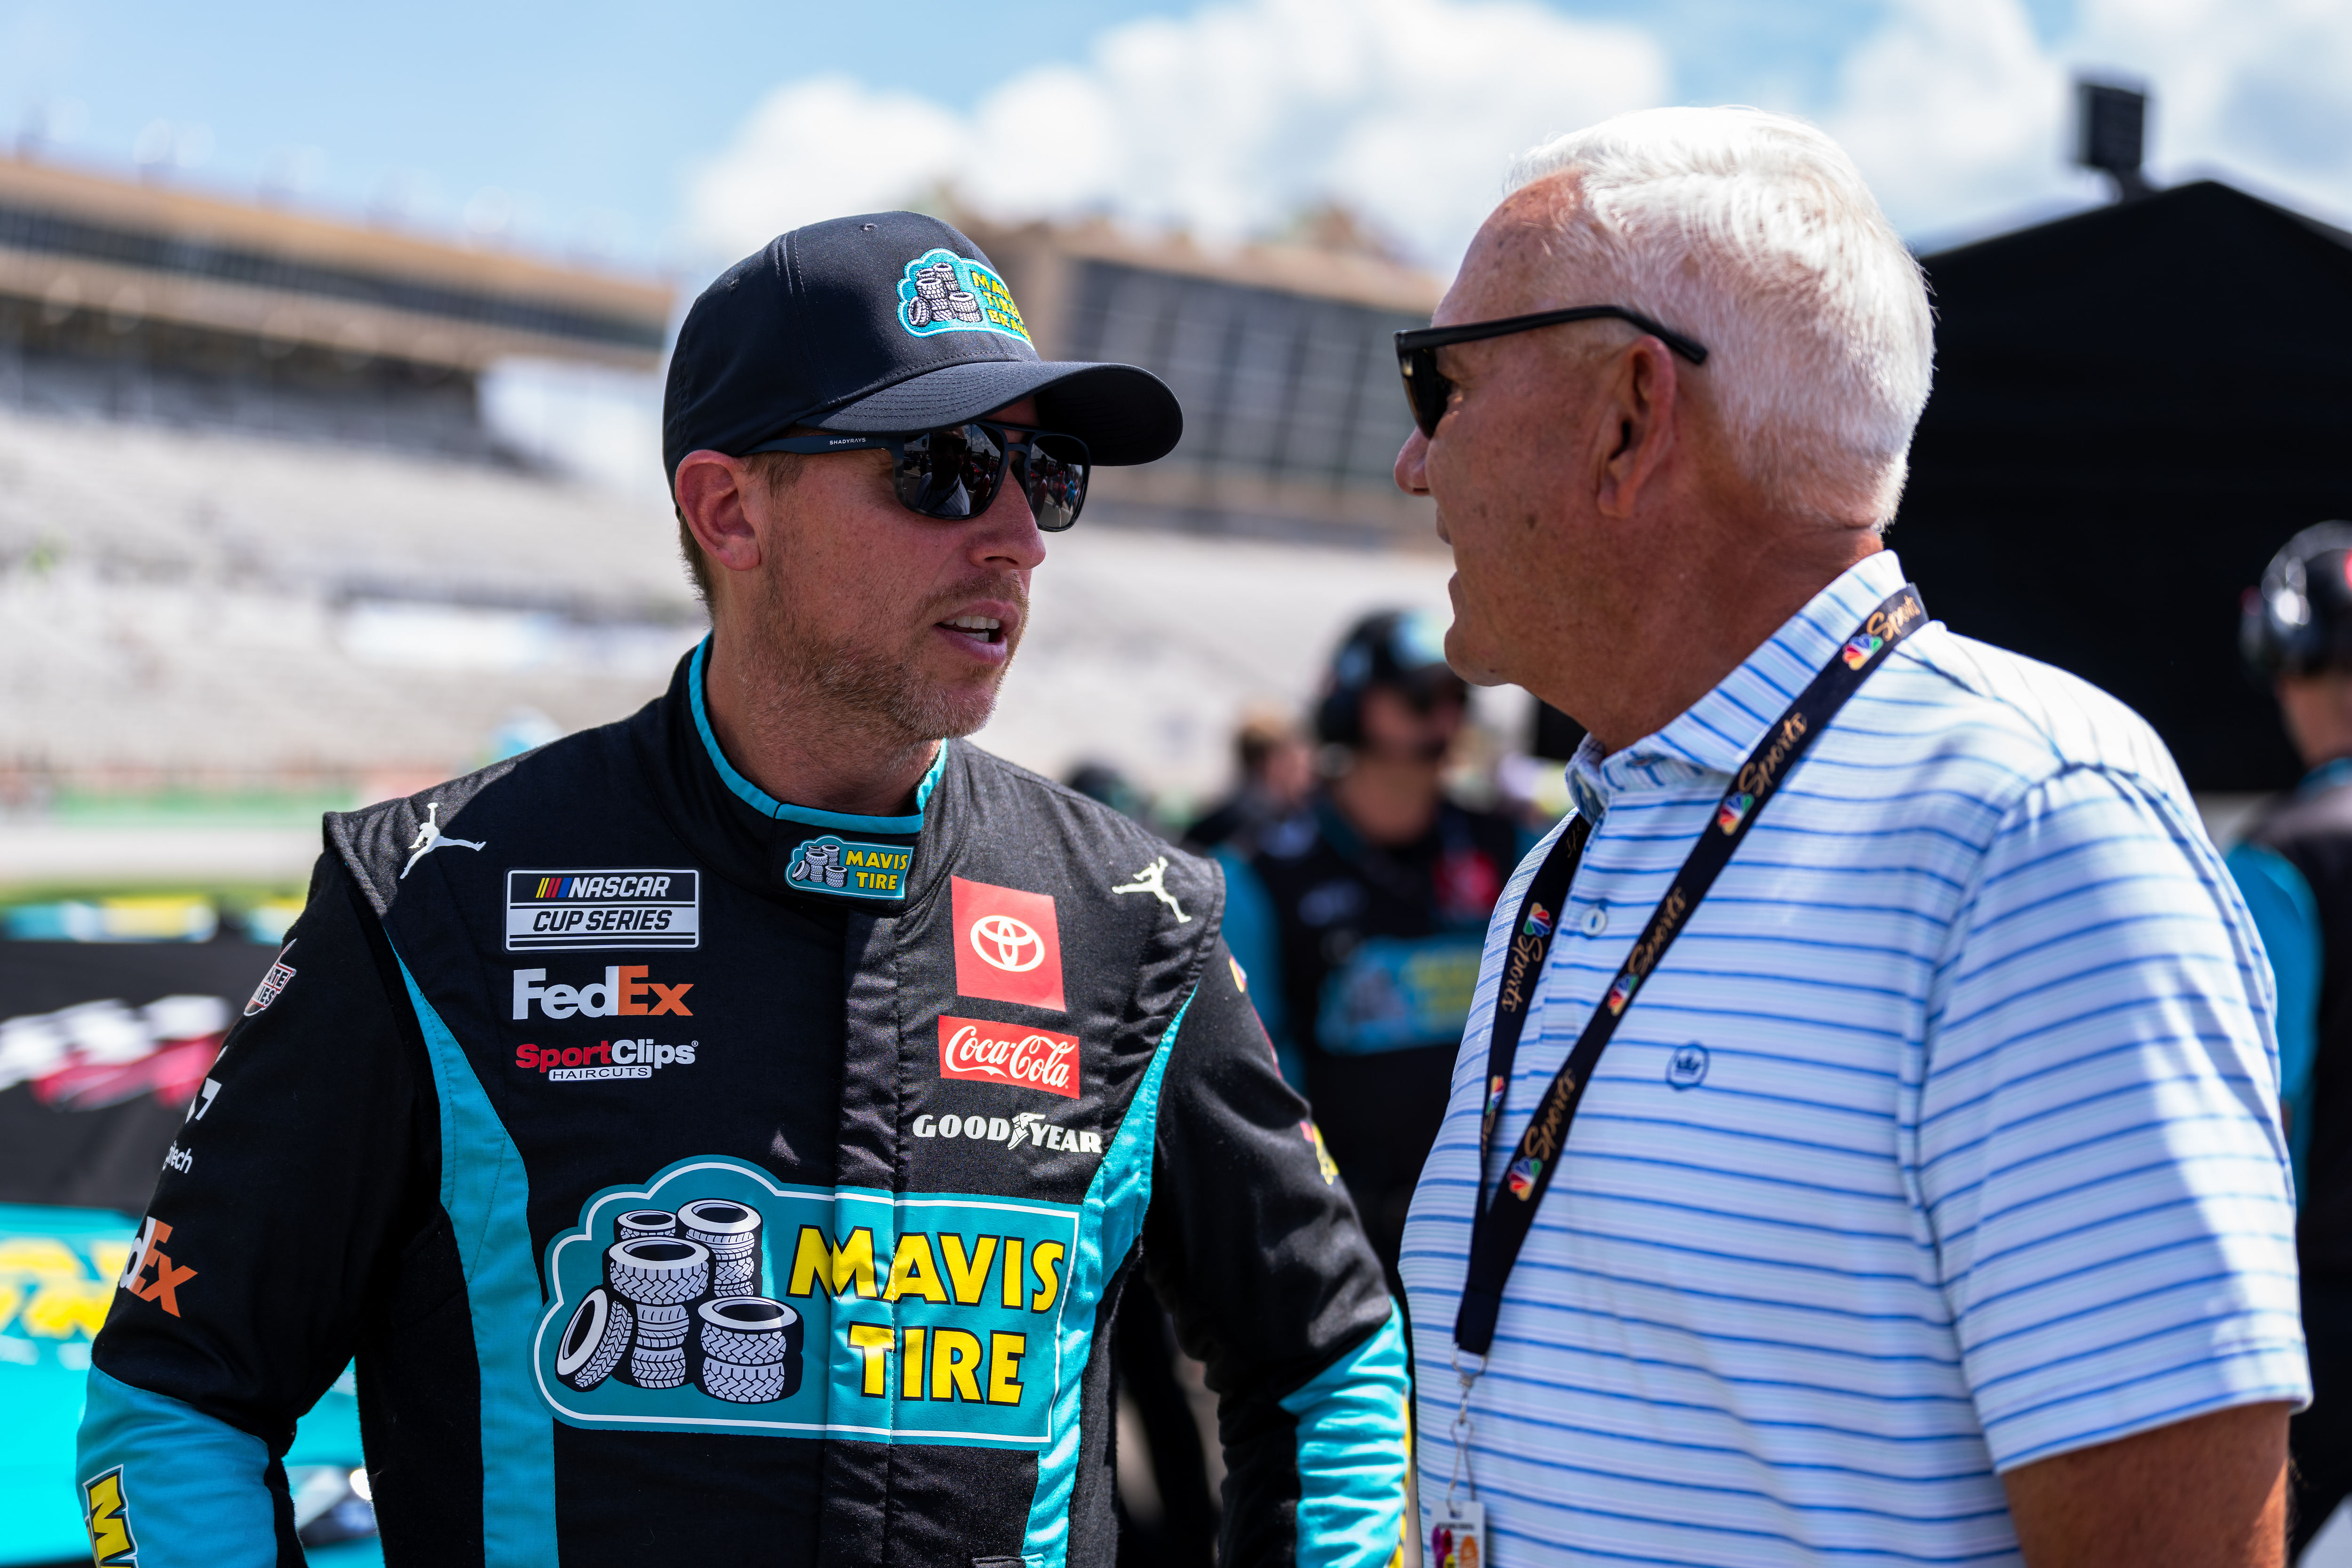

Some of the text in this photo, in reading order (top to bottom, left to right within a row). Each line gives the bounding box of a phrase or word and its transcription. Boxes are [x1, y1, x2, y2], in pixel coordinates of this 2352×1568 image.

[1738, 712, 1807, 797] Sports
[568, 876, 671, 898] NASCAR
[845, 850, 908, 870] MAVIS
[856, 871, 898, 890] TIRE
[532, 909, 673, 931] CUP SERIES
[1628, 887, 1686, 976] Sports
[513, 965, 694, 1020] FedEx
[553, 1067, 648, 1080] HAIRCUTS
[945, 1026, 1075, 1088] Coca-Cola
[1524, 1068, 1575, 1161] Sports
[787, 1224, 1066, 1314] MAVIS
[847, 1321, 1027, 1406] TIRE
